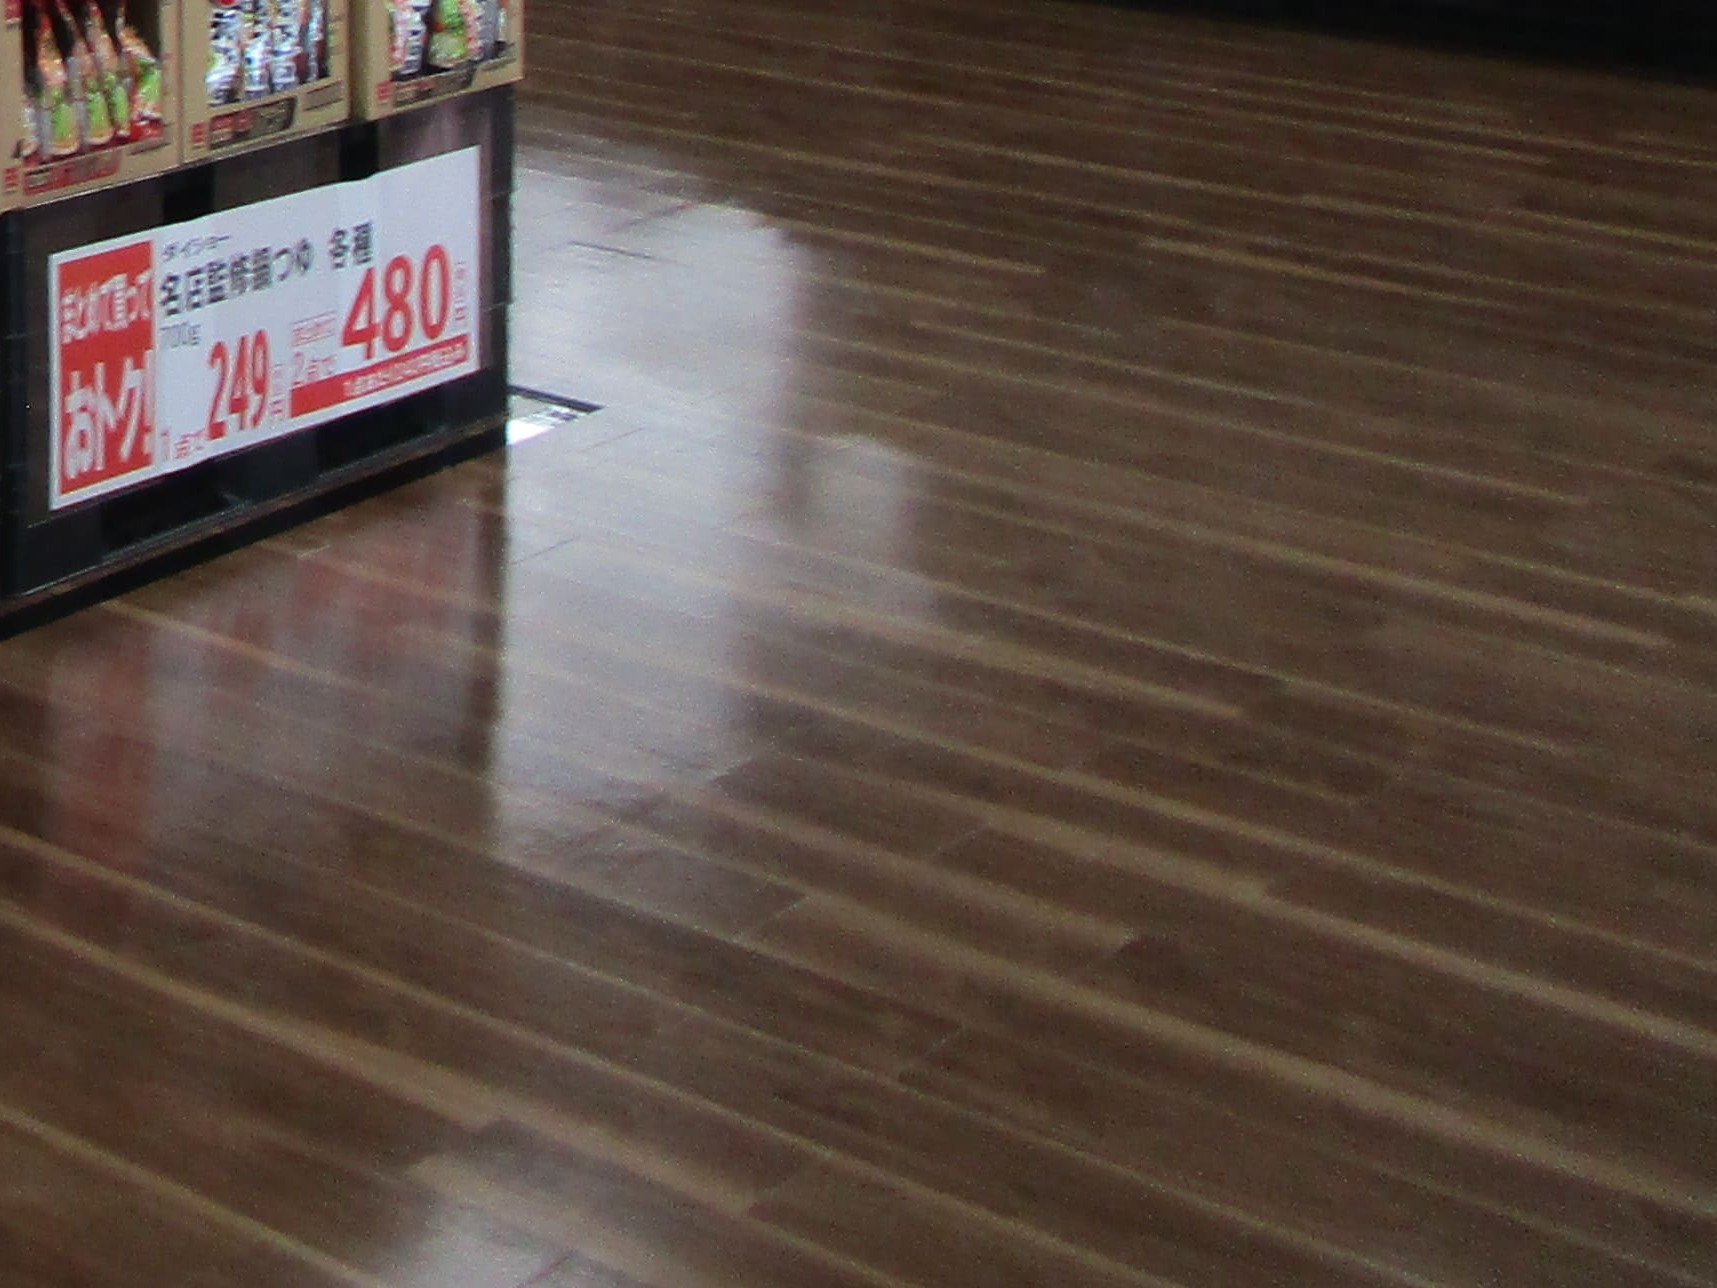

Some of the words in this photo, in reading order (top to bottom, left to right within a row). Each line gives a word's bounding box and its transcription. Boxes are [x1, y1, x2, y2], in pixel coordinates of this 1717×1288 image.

[328, 220, 374, 270] 各種
[341, 243, 452, 360] 480
[65, 349, 156, 480] おトク!
[205, 330, 271, 442] 249
